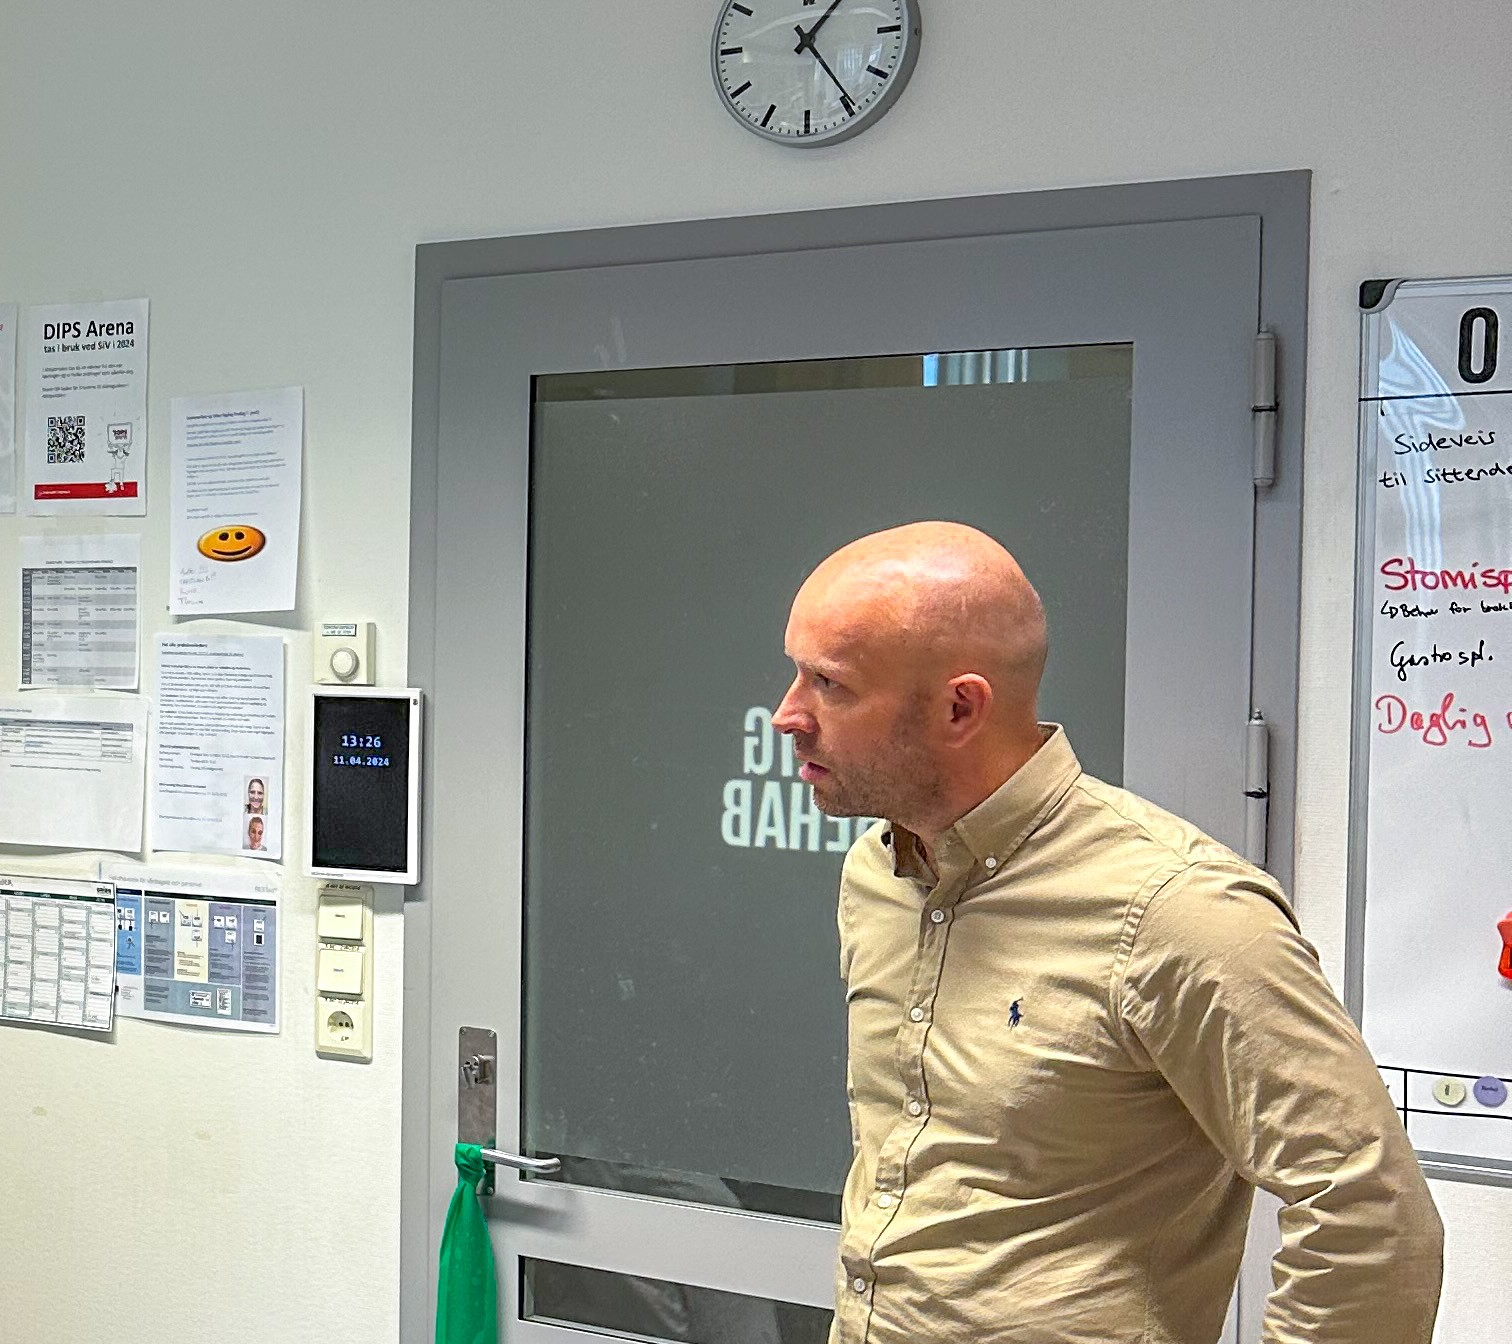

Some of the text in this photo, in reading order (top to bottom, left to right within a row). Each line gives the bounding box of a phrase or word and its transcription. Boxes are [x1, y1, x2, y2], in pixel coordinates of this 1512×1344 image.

[43, 320, 134, 341] DIPS Arena
[61, 342, 80, 353] bruk
[81, 341, 96, 351] ved
[116, 338, 135, 349] 2024
[1393, 429, 1496, 455] Sideveis
[1378, 470, 1408, 488] til
[1375, 692, 1493, 748] Daglig
[341, 735, 382, 748] 13:26
[333, 755, 390, 767] 11.04.2024
